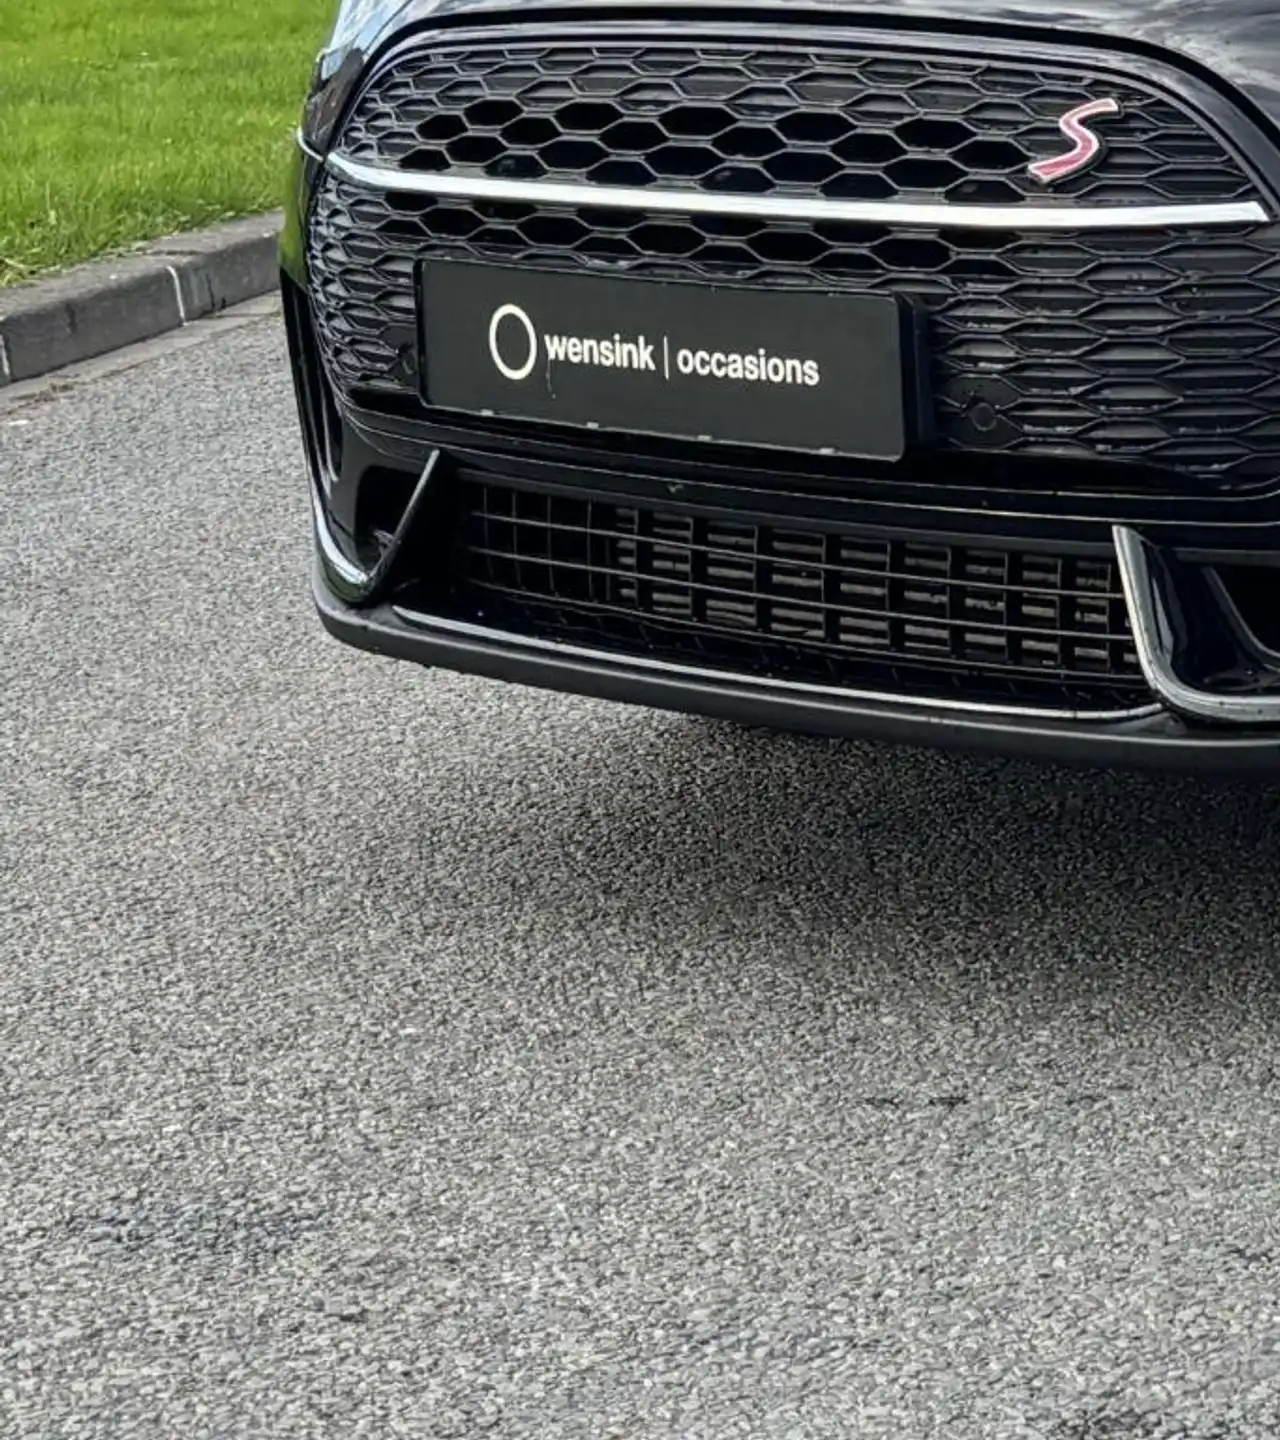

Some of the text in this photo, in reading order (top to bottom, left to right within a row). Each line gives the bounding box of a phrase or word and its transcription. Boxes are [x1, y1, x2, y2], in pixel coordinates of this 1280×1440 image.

[1027, 97, 1119, 184] S
[544, 333, 819, 385] wensink occasions
